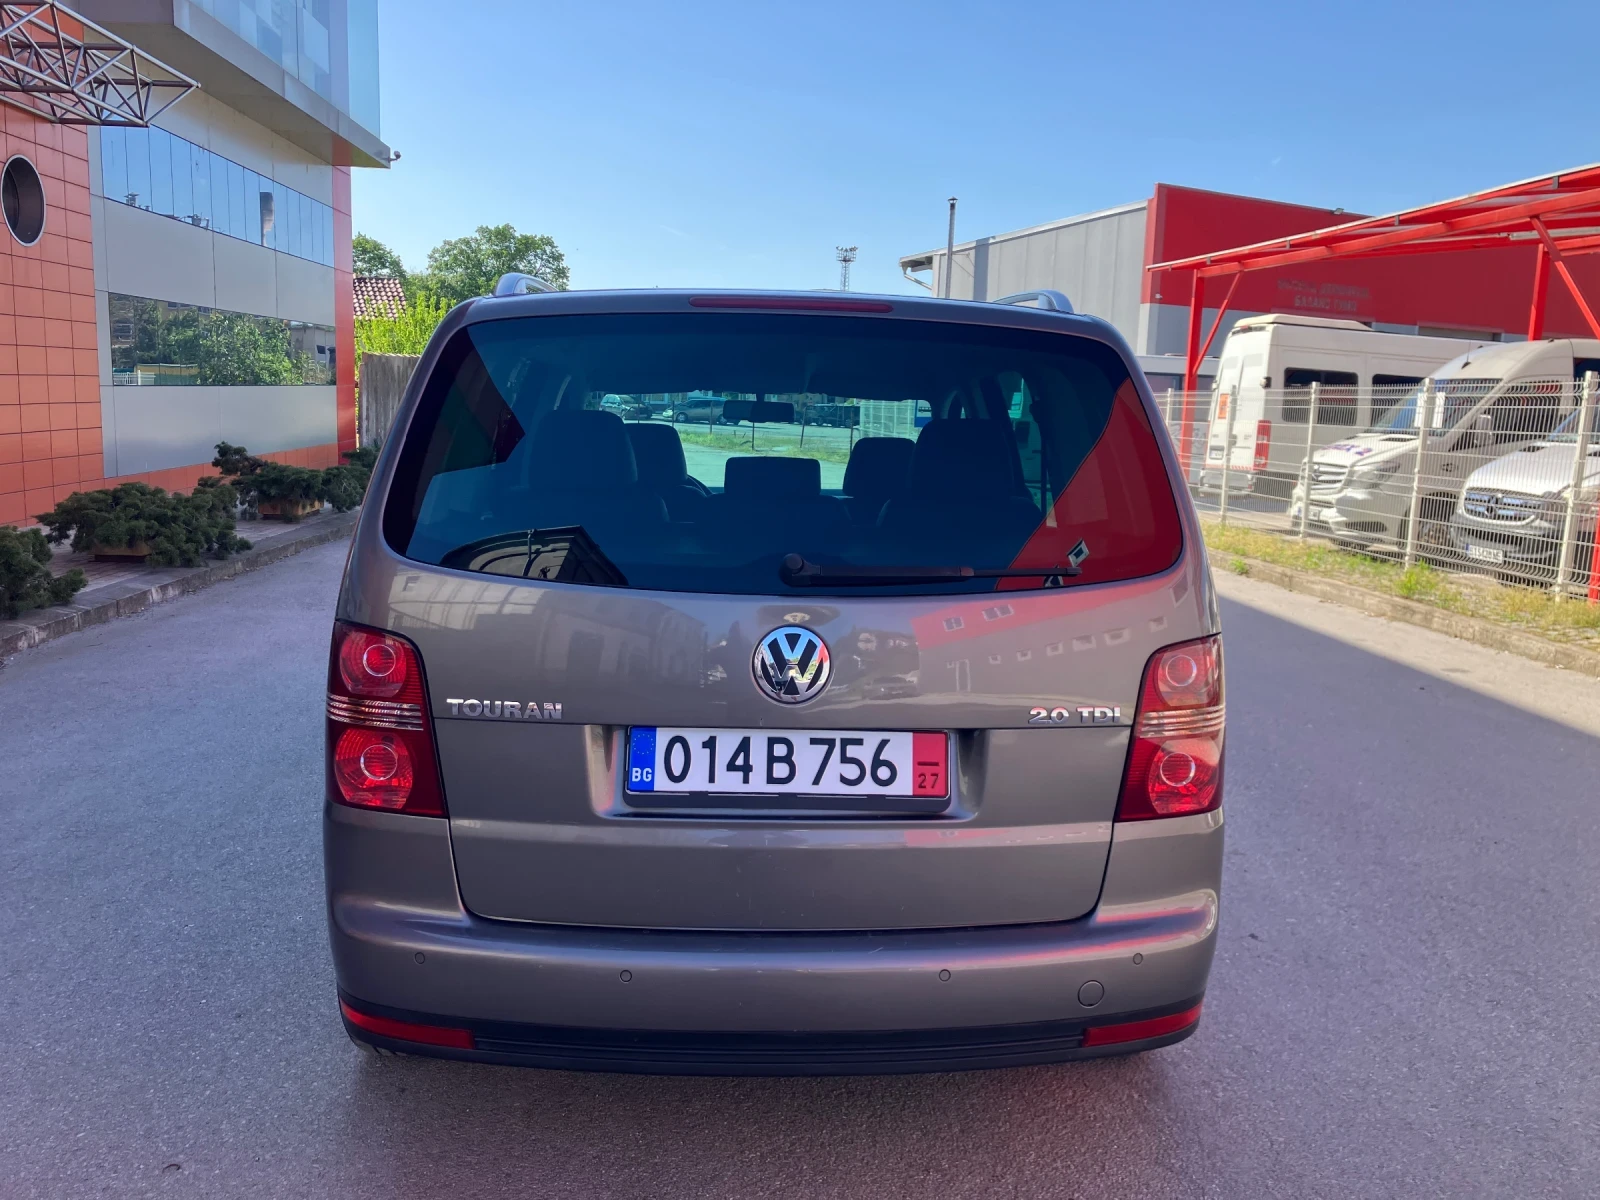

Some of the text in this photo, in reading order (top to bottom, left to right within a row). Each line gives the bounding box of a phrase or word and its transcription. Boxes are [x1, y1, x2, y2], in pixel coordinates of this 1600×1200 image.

[446, 698, 562, 720] TOURAN
[1076, 706, 1121, 724] TDI
[631, 767, 652, 782] BG
[917, 773, 940, 789] 27
